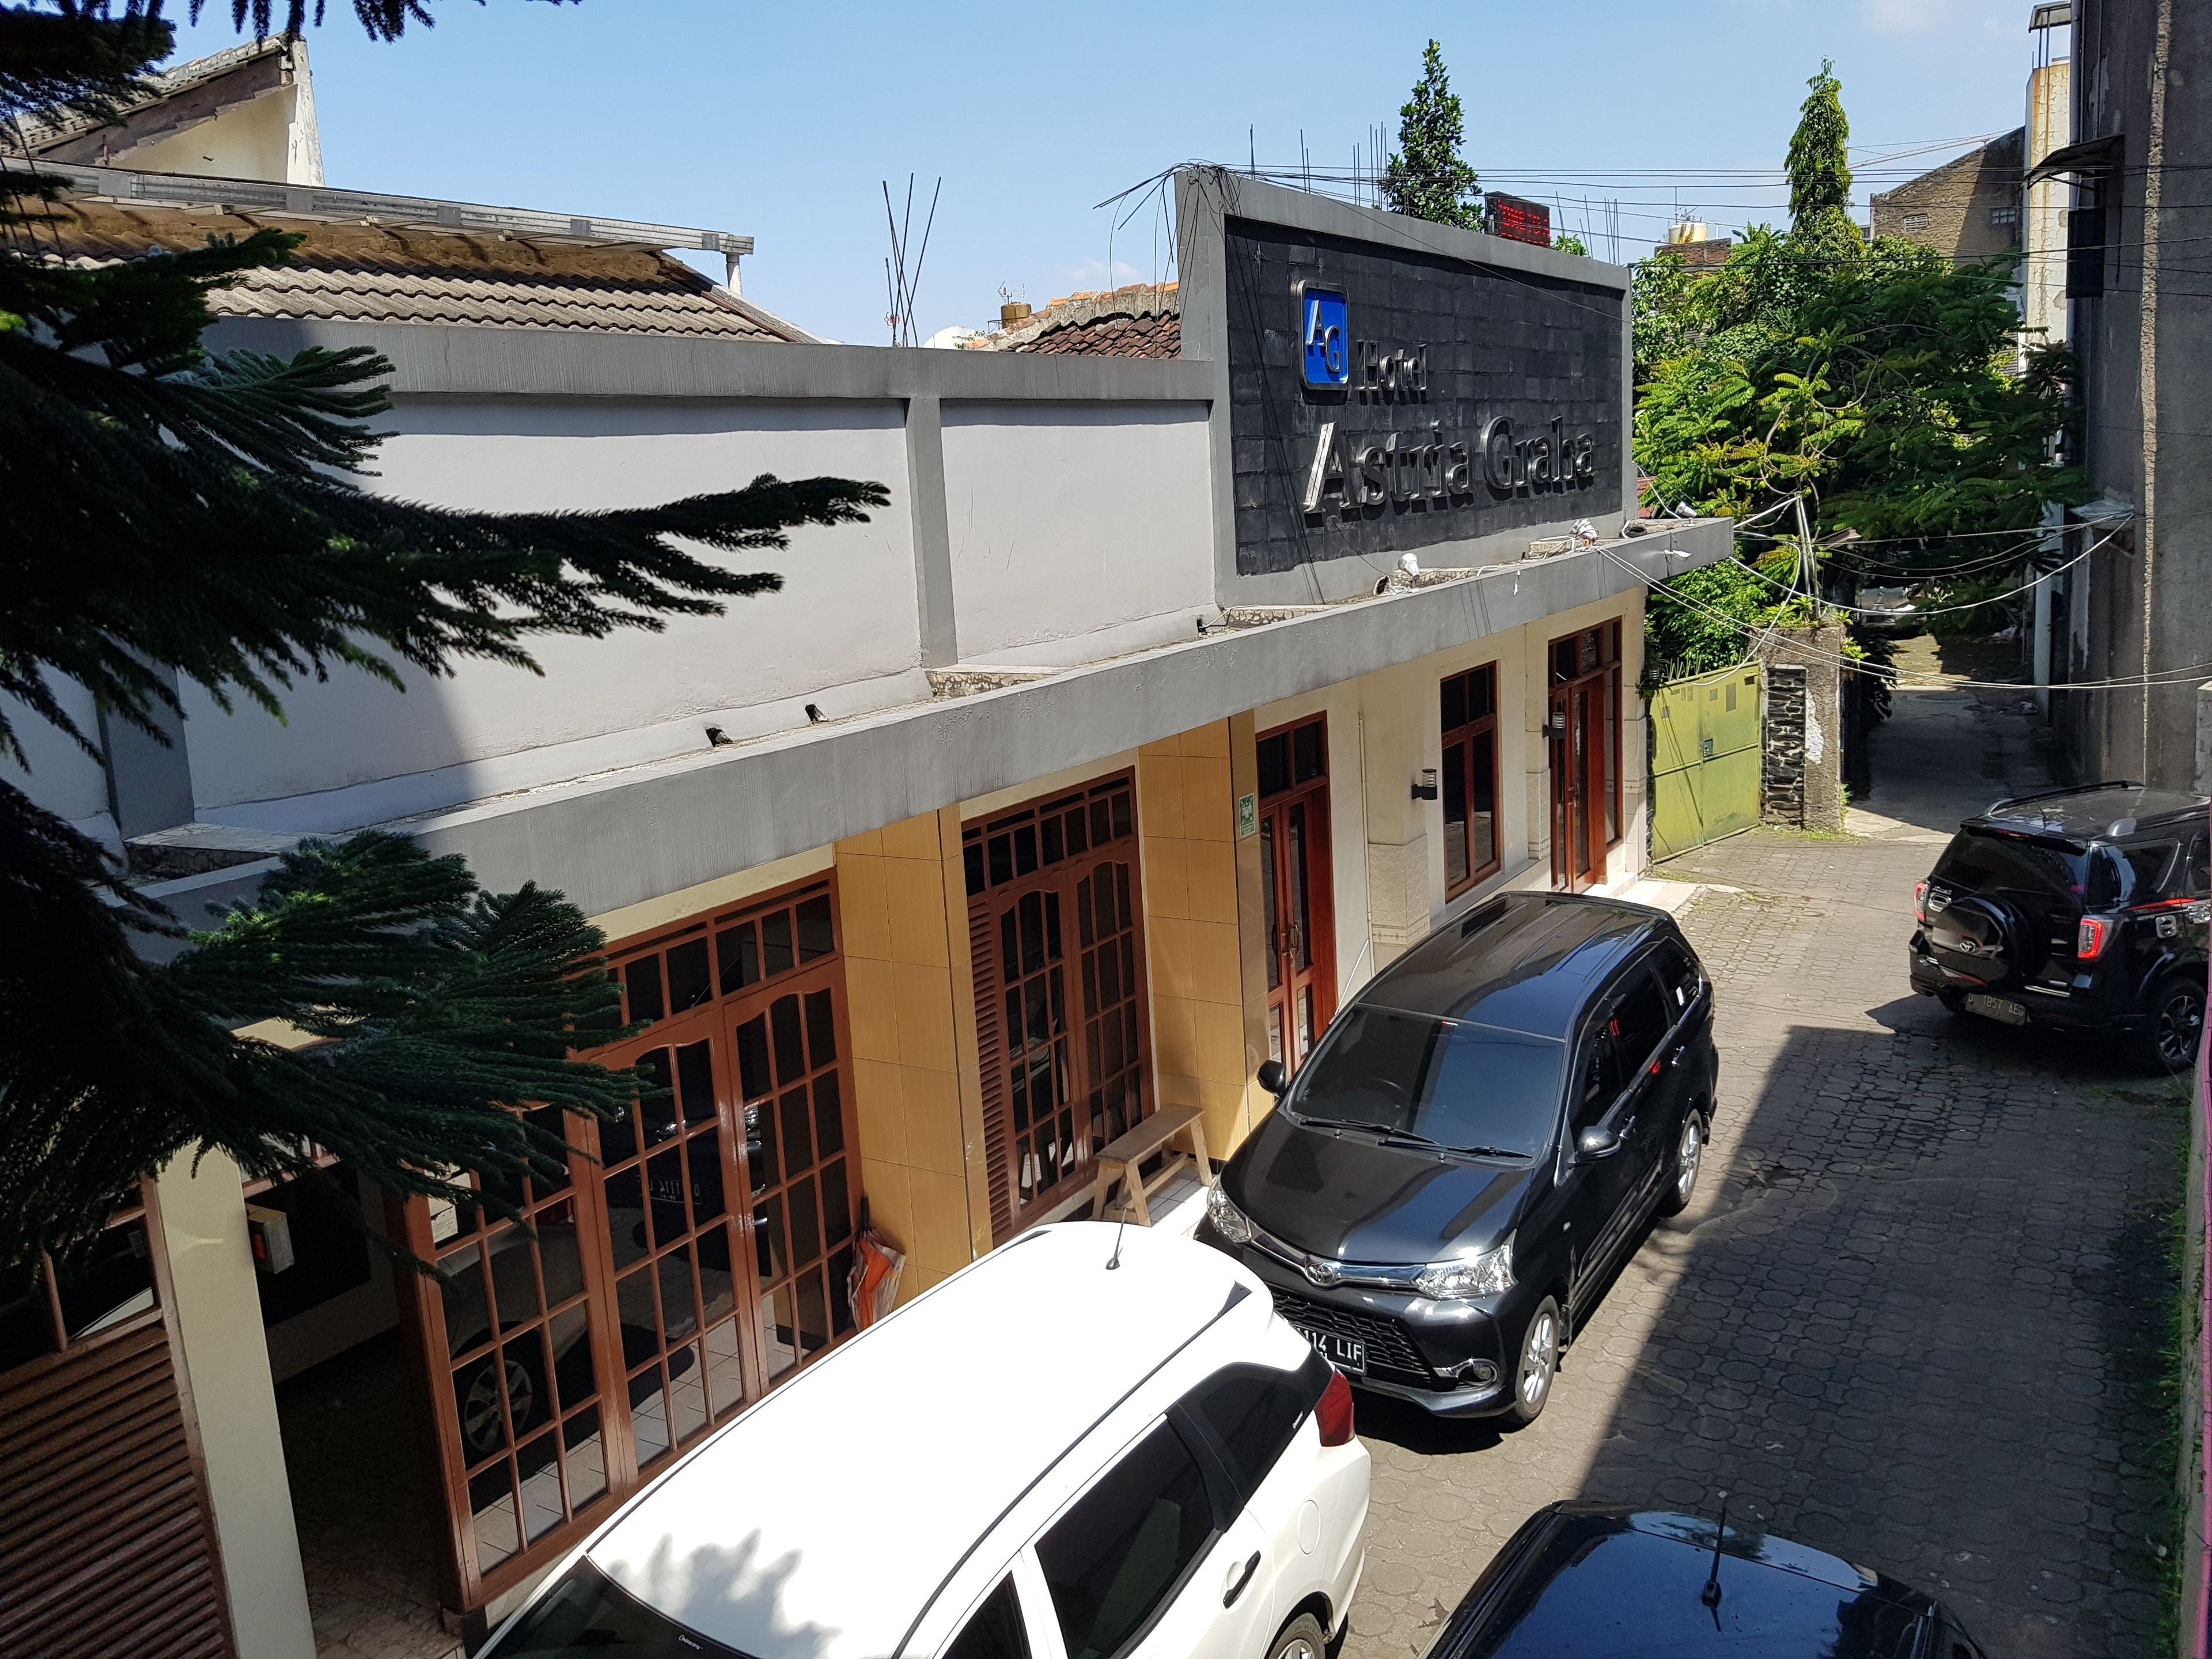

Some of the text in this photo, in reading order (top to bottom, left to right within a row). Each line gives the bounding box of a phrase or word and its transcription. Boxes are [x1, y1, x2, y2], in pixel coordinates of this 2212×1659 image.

[1306, 300, 1341, 373] AG
[1355, 339, 1428, 391] Hotel
[1302, 415, 1593, 512] Astria Graha
[1983, 995, 2003, 1010] 1857
[1336, 1339, 1362, 1361] LIF
